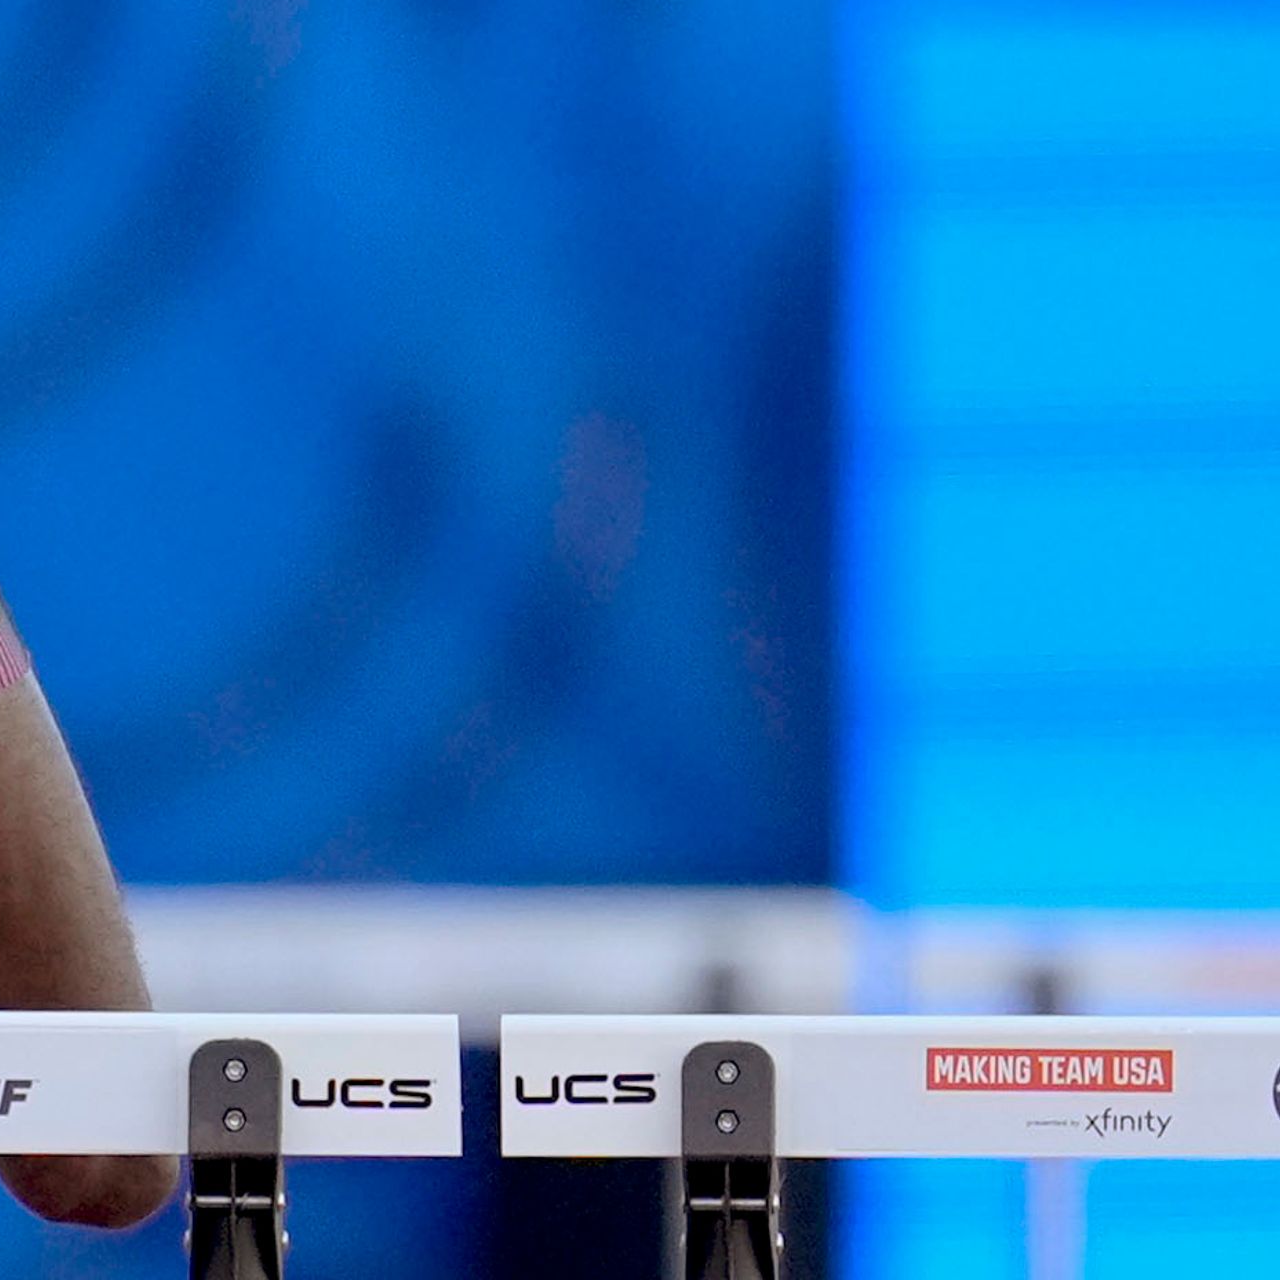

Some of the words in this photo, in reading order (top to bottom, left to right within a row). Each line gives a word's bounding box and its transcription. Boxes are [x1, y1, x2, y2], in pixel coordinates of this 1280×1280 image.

[934, 1055, 1031, 1084] MAKING
[1038, 1056, 1104, 1085] TEAM
[1113, 1056, 1164, 1085] USA
[291, 1078, 431, 1109] UCS
[515, 1073, 656, 1105] UCS
[1085, 1107, 1172, 1138] xfinity
